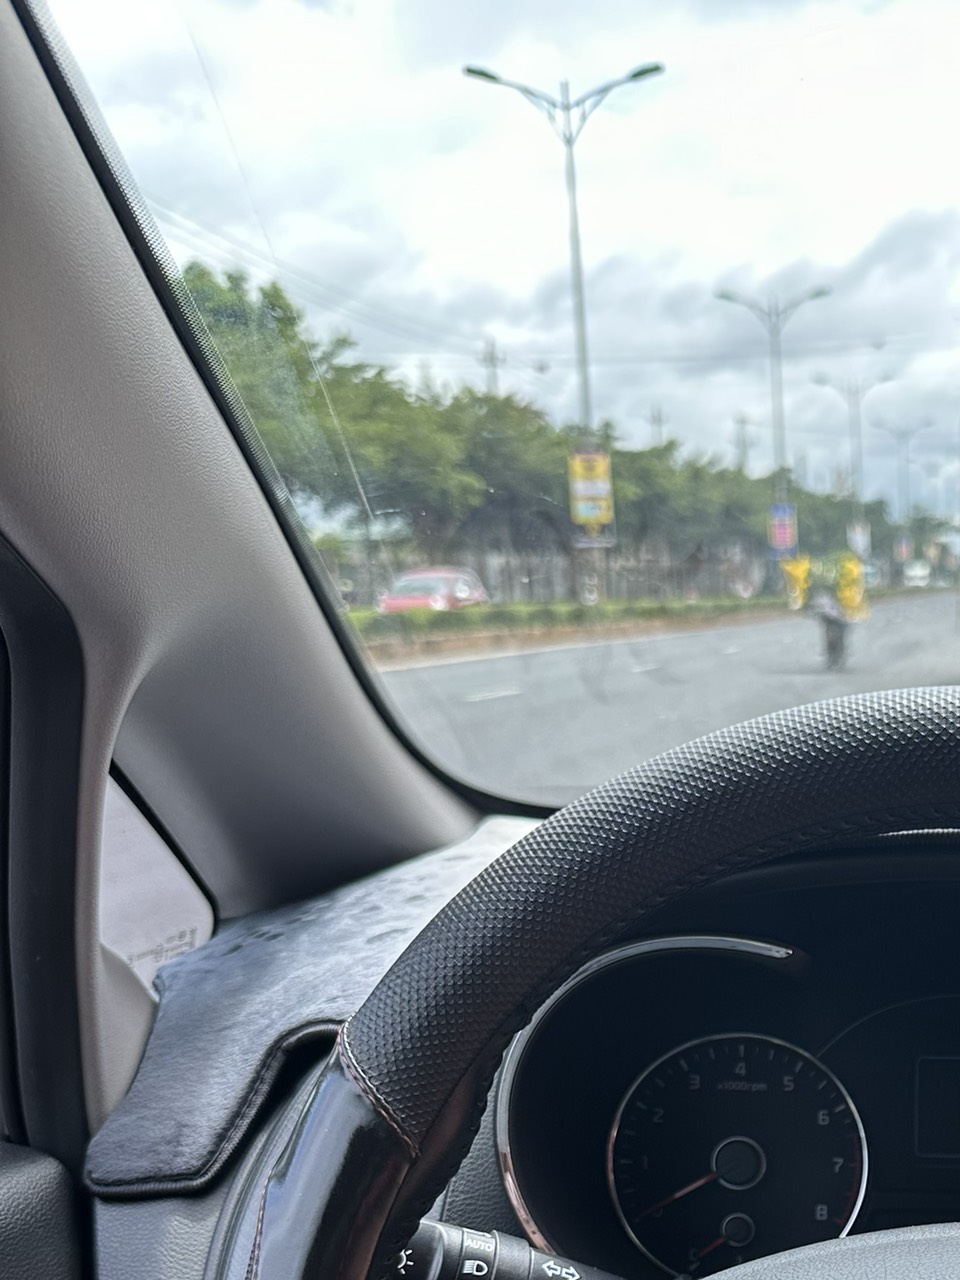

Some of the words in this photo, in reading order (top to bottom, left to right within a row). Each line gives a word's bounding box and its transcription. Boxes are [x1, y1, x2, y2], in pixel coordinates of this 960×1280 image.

[735, 1062, 747, 1077] 4
[689, 1075, 701, 1090] 3
[783, 1076, 795, 1091] 5
[653, 1108, 665, 1123] 2
[817, 1110, 830, 1126] 6
[832, 1158, 844, 1173] 7
[815, 1205, 828, 1221] 8
[465, 1238, 494, 1253] AUTO
